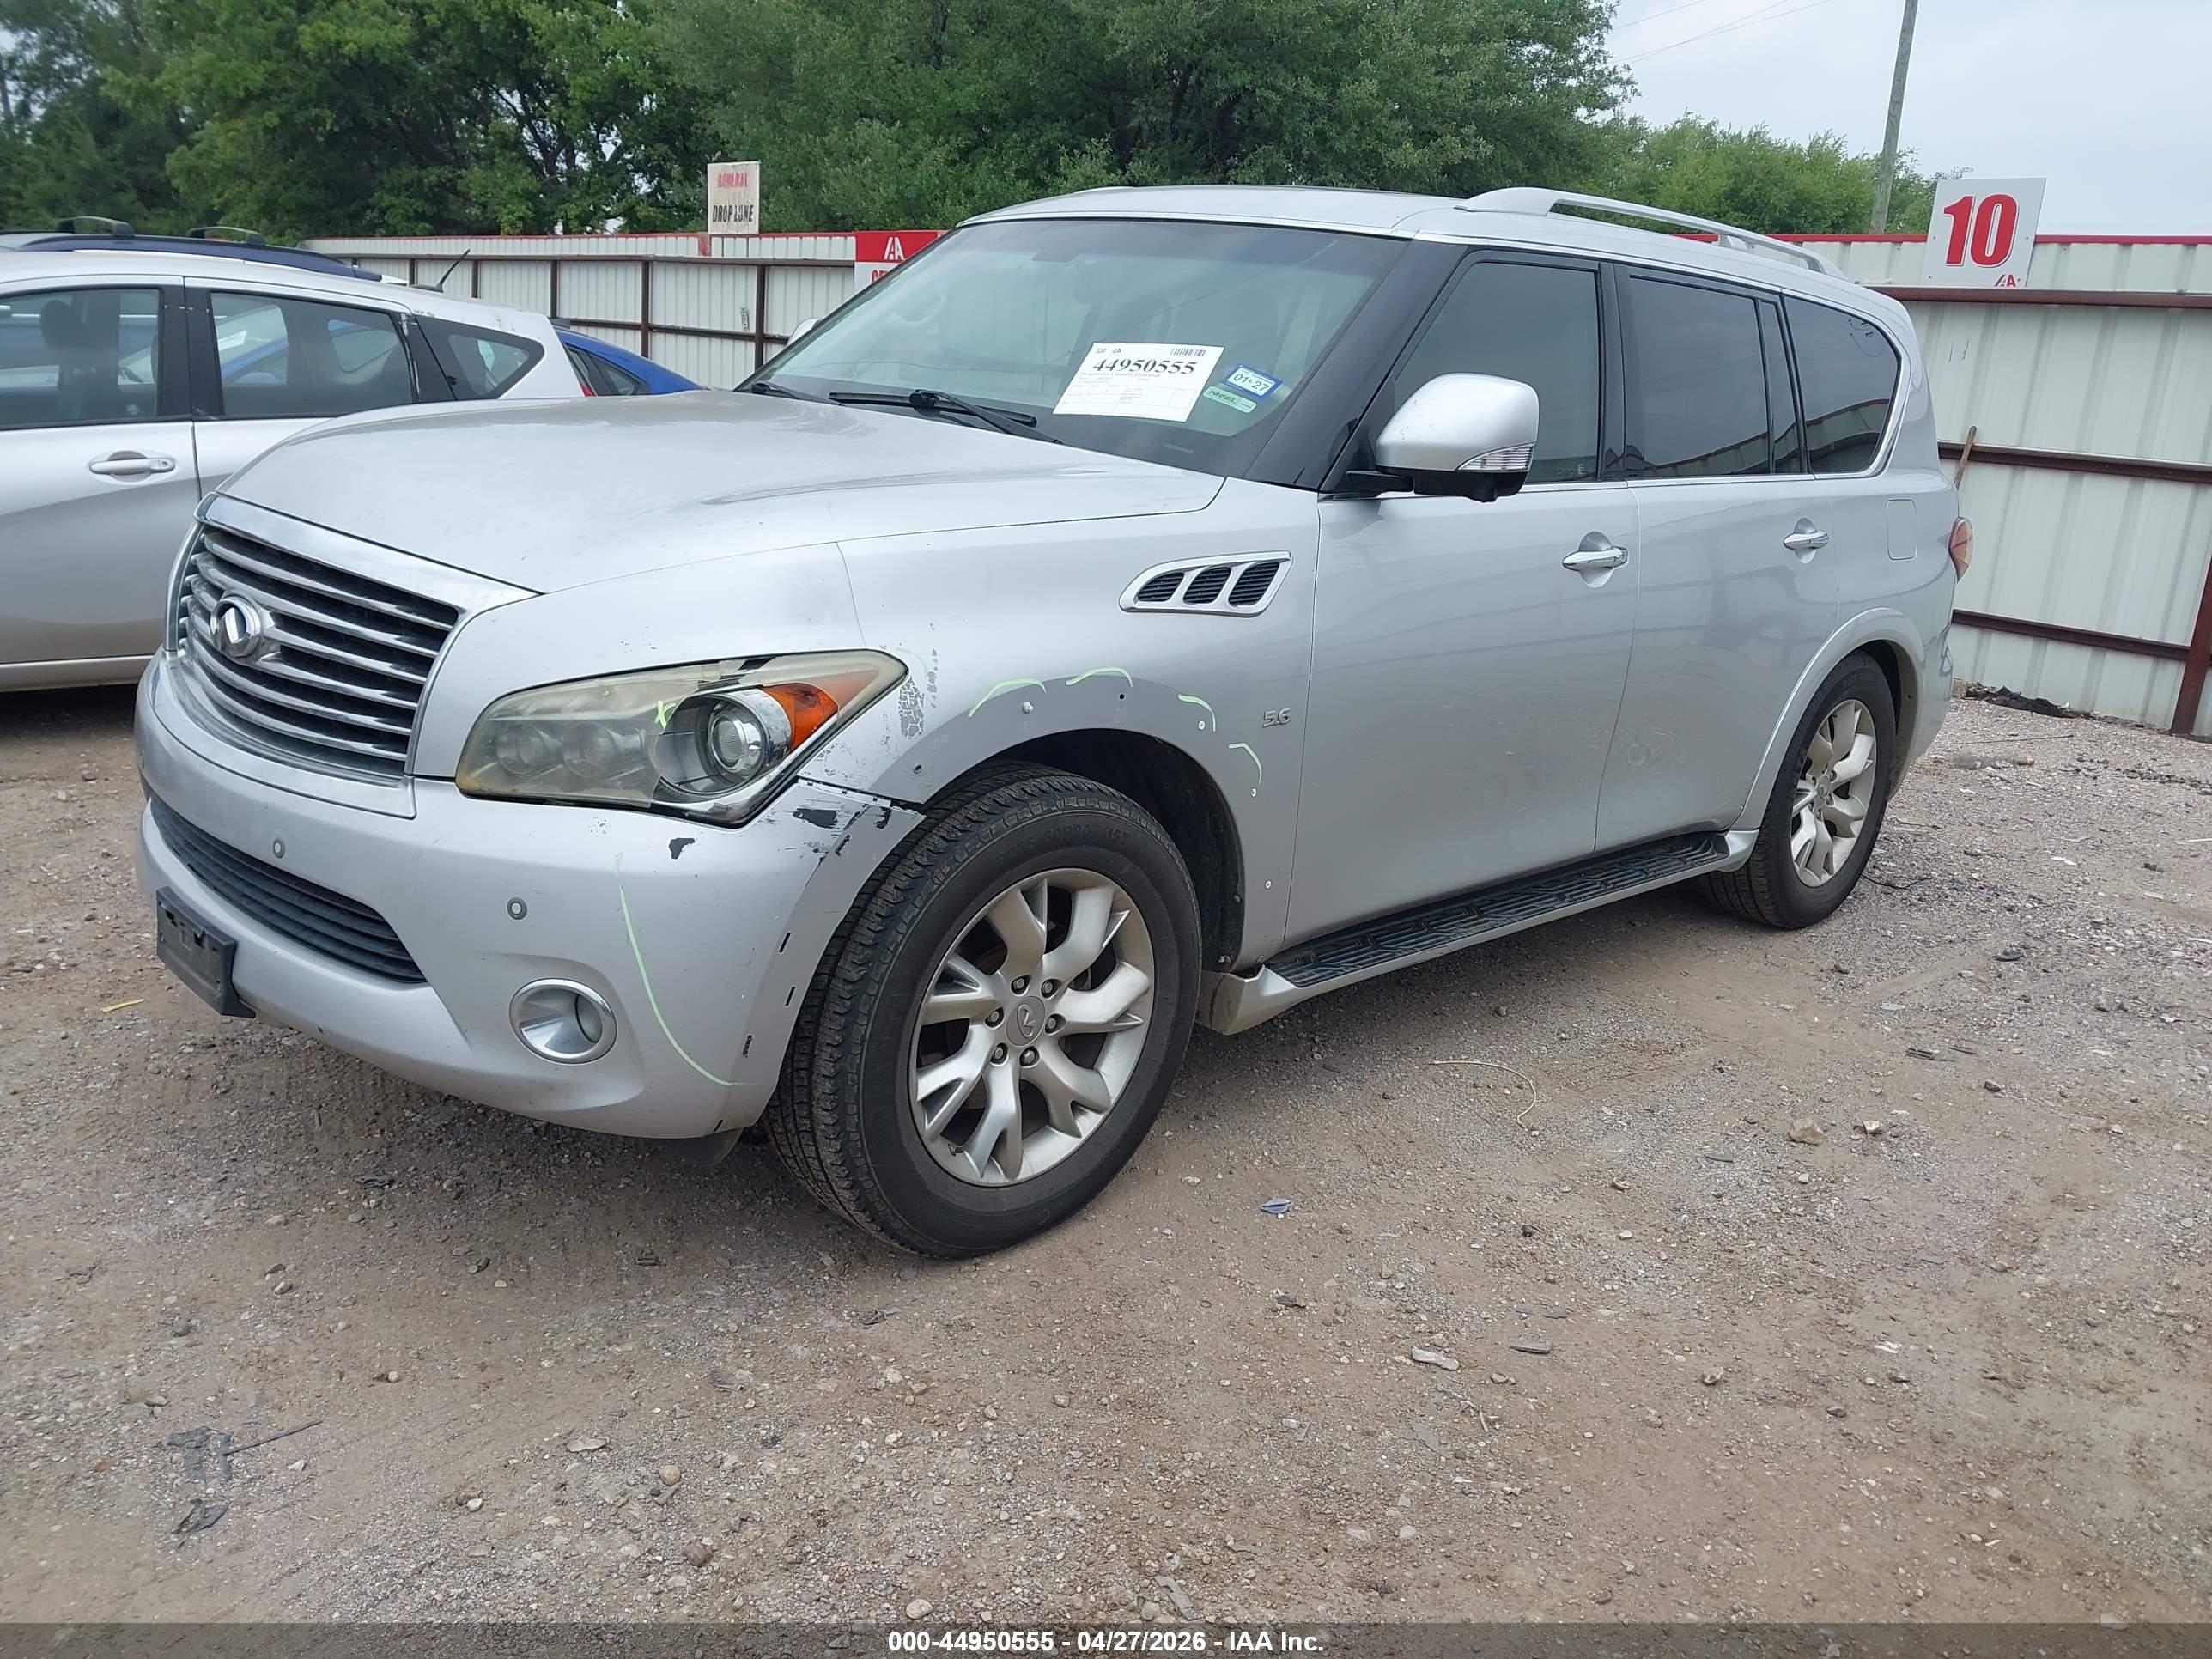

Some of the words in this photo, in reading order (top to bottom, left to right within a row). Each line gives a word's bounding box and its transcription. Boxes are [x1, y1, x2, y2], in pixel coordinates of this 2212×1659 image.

[712, 205, 733, 222] DROP
[1943, 194, 2019, 268] 10
[1092, 358, 1199, 374] 44950555
[1233, 374, 1249, 384] 01
[1251, 380, 1270, 392] 27
[1262, 708, 1291, 727] 5.6
